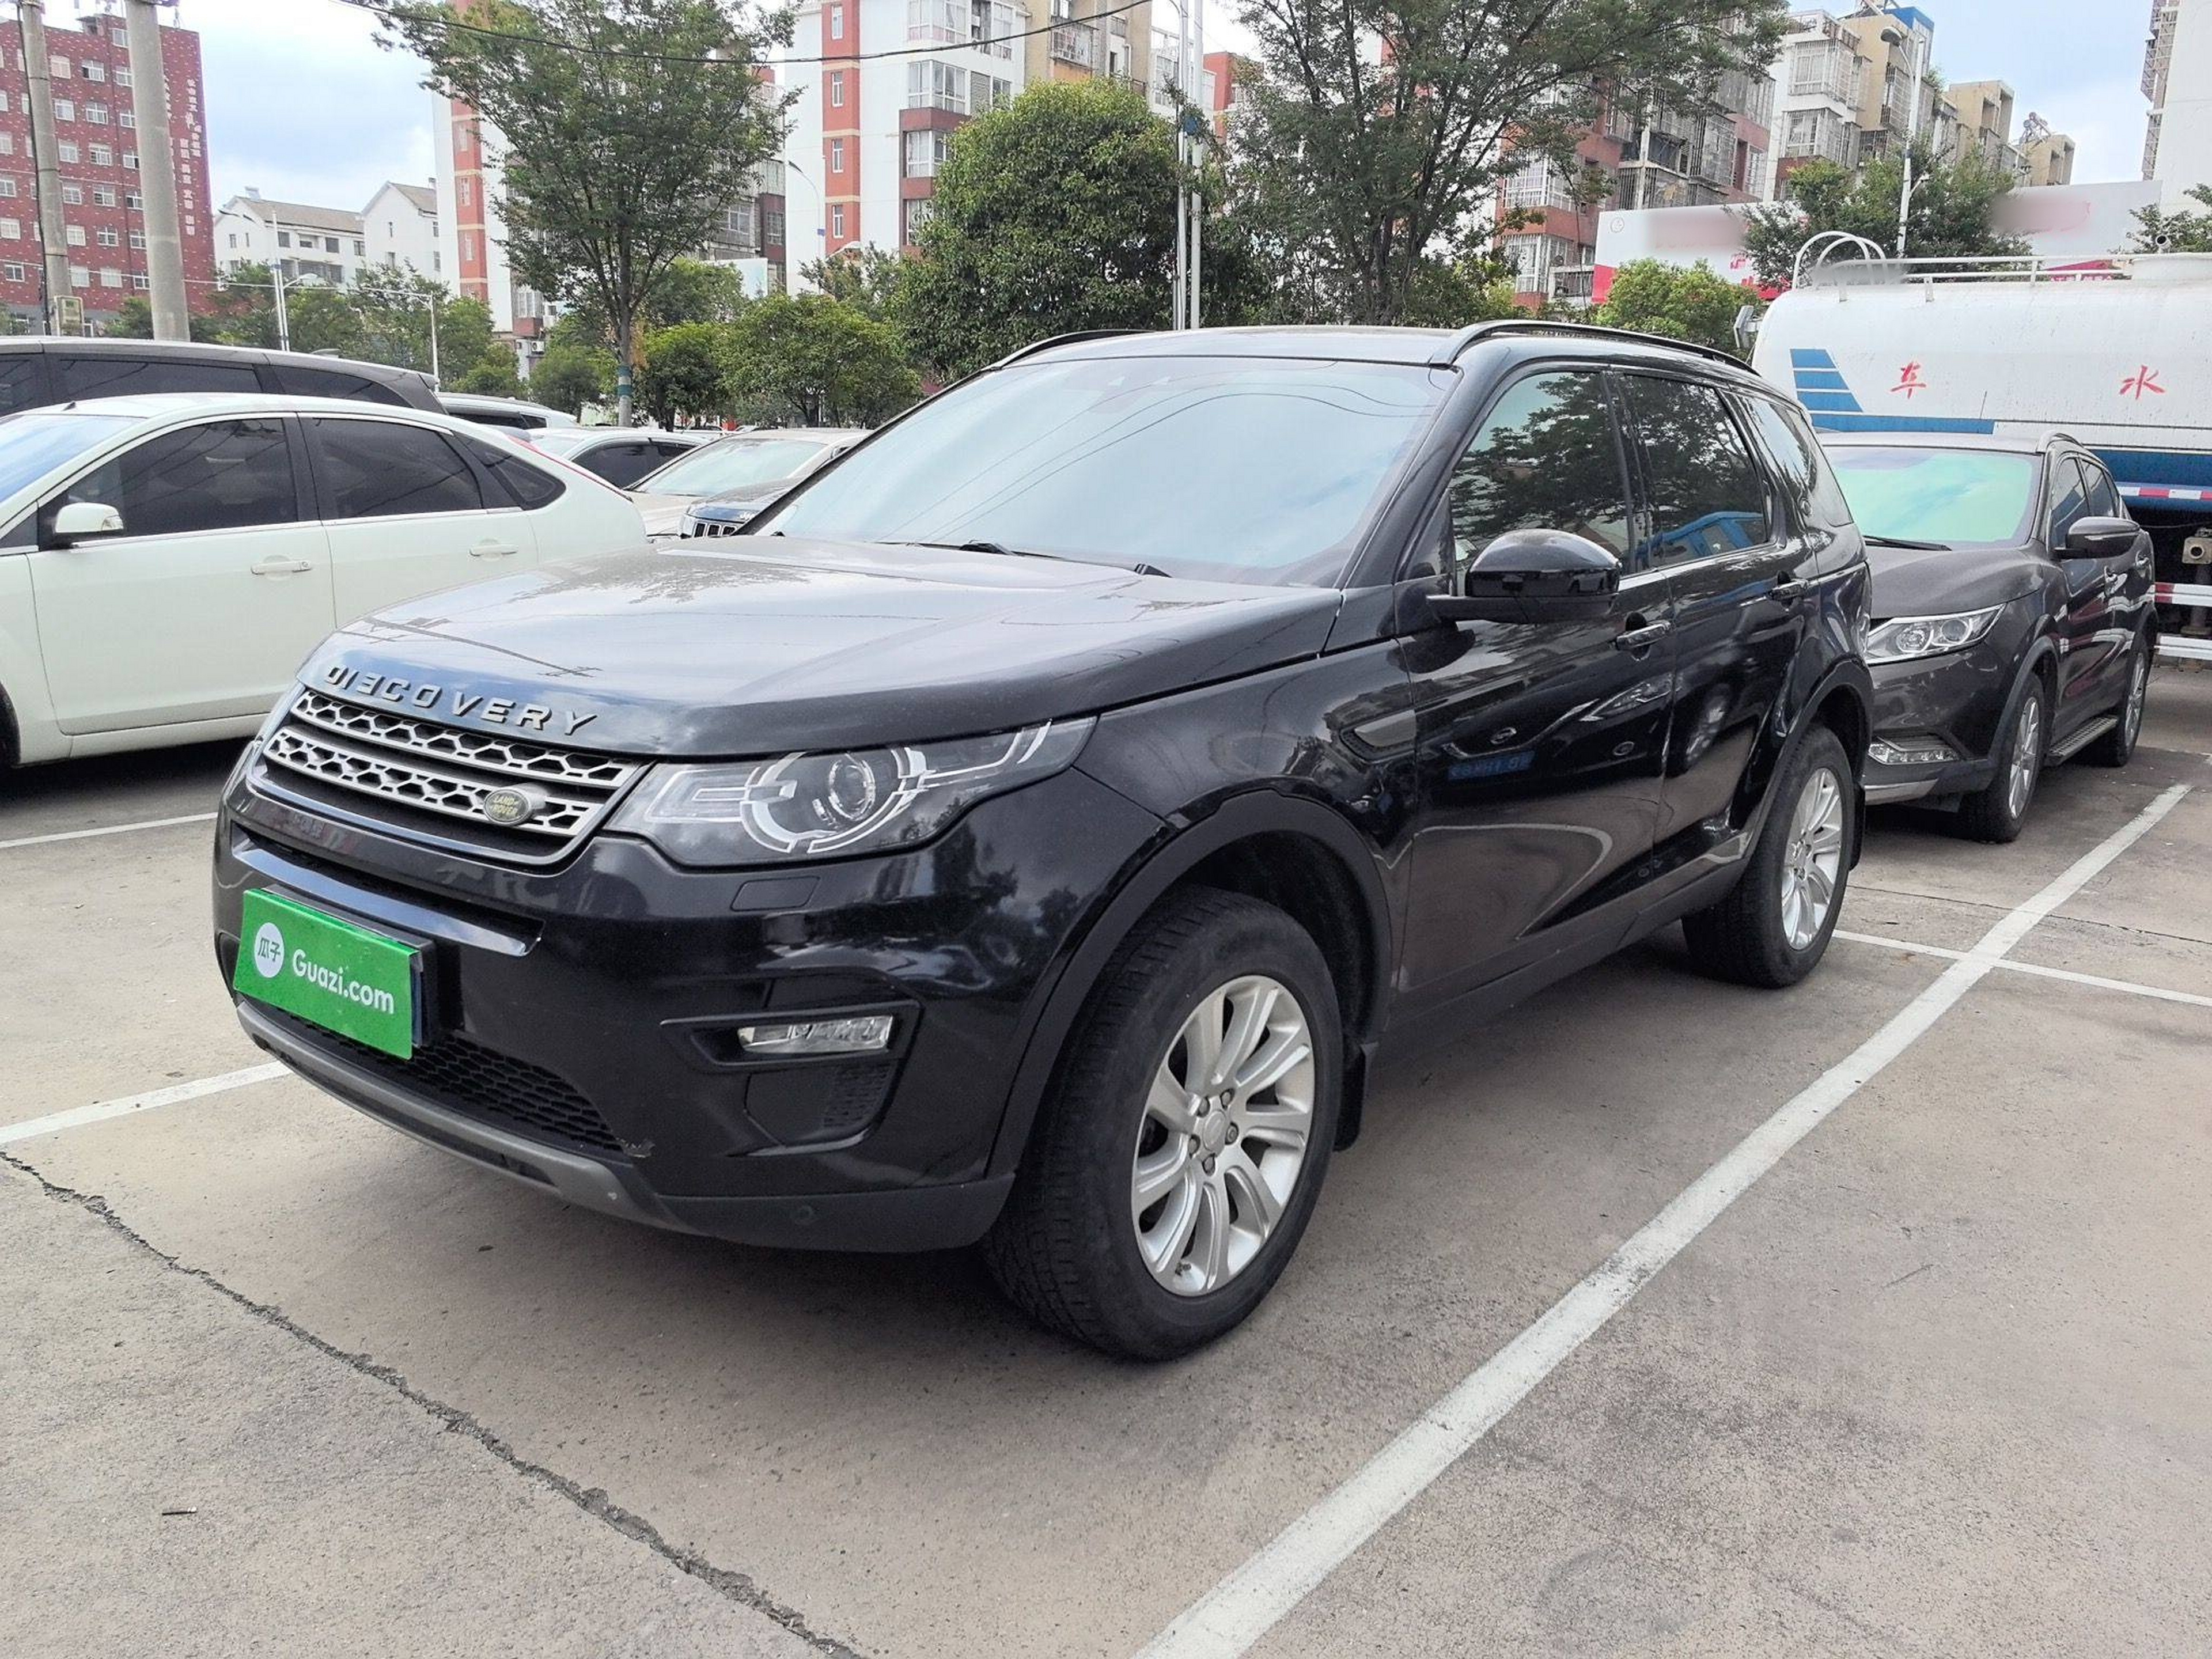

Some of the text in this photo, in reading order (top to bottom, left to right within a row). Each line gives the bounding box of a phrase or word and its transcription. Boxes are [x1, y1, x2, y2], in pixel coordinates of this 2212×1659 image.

[1890, 362, 2166, 400] 车 水
[257, 937, 281, 963] 瓜子
[292, 949, 395, 1014] Guazi.com
